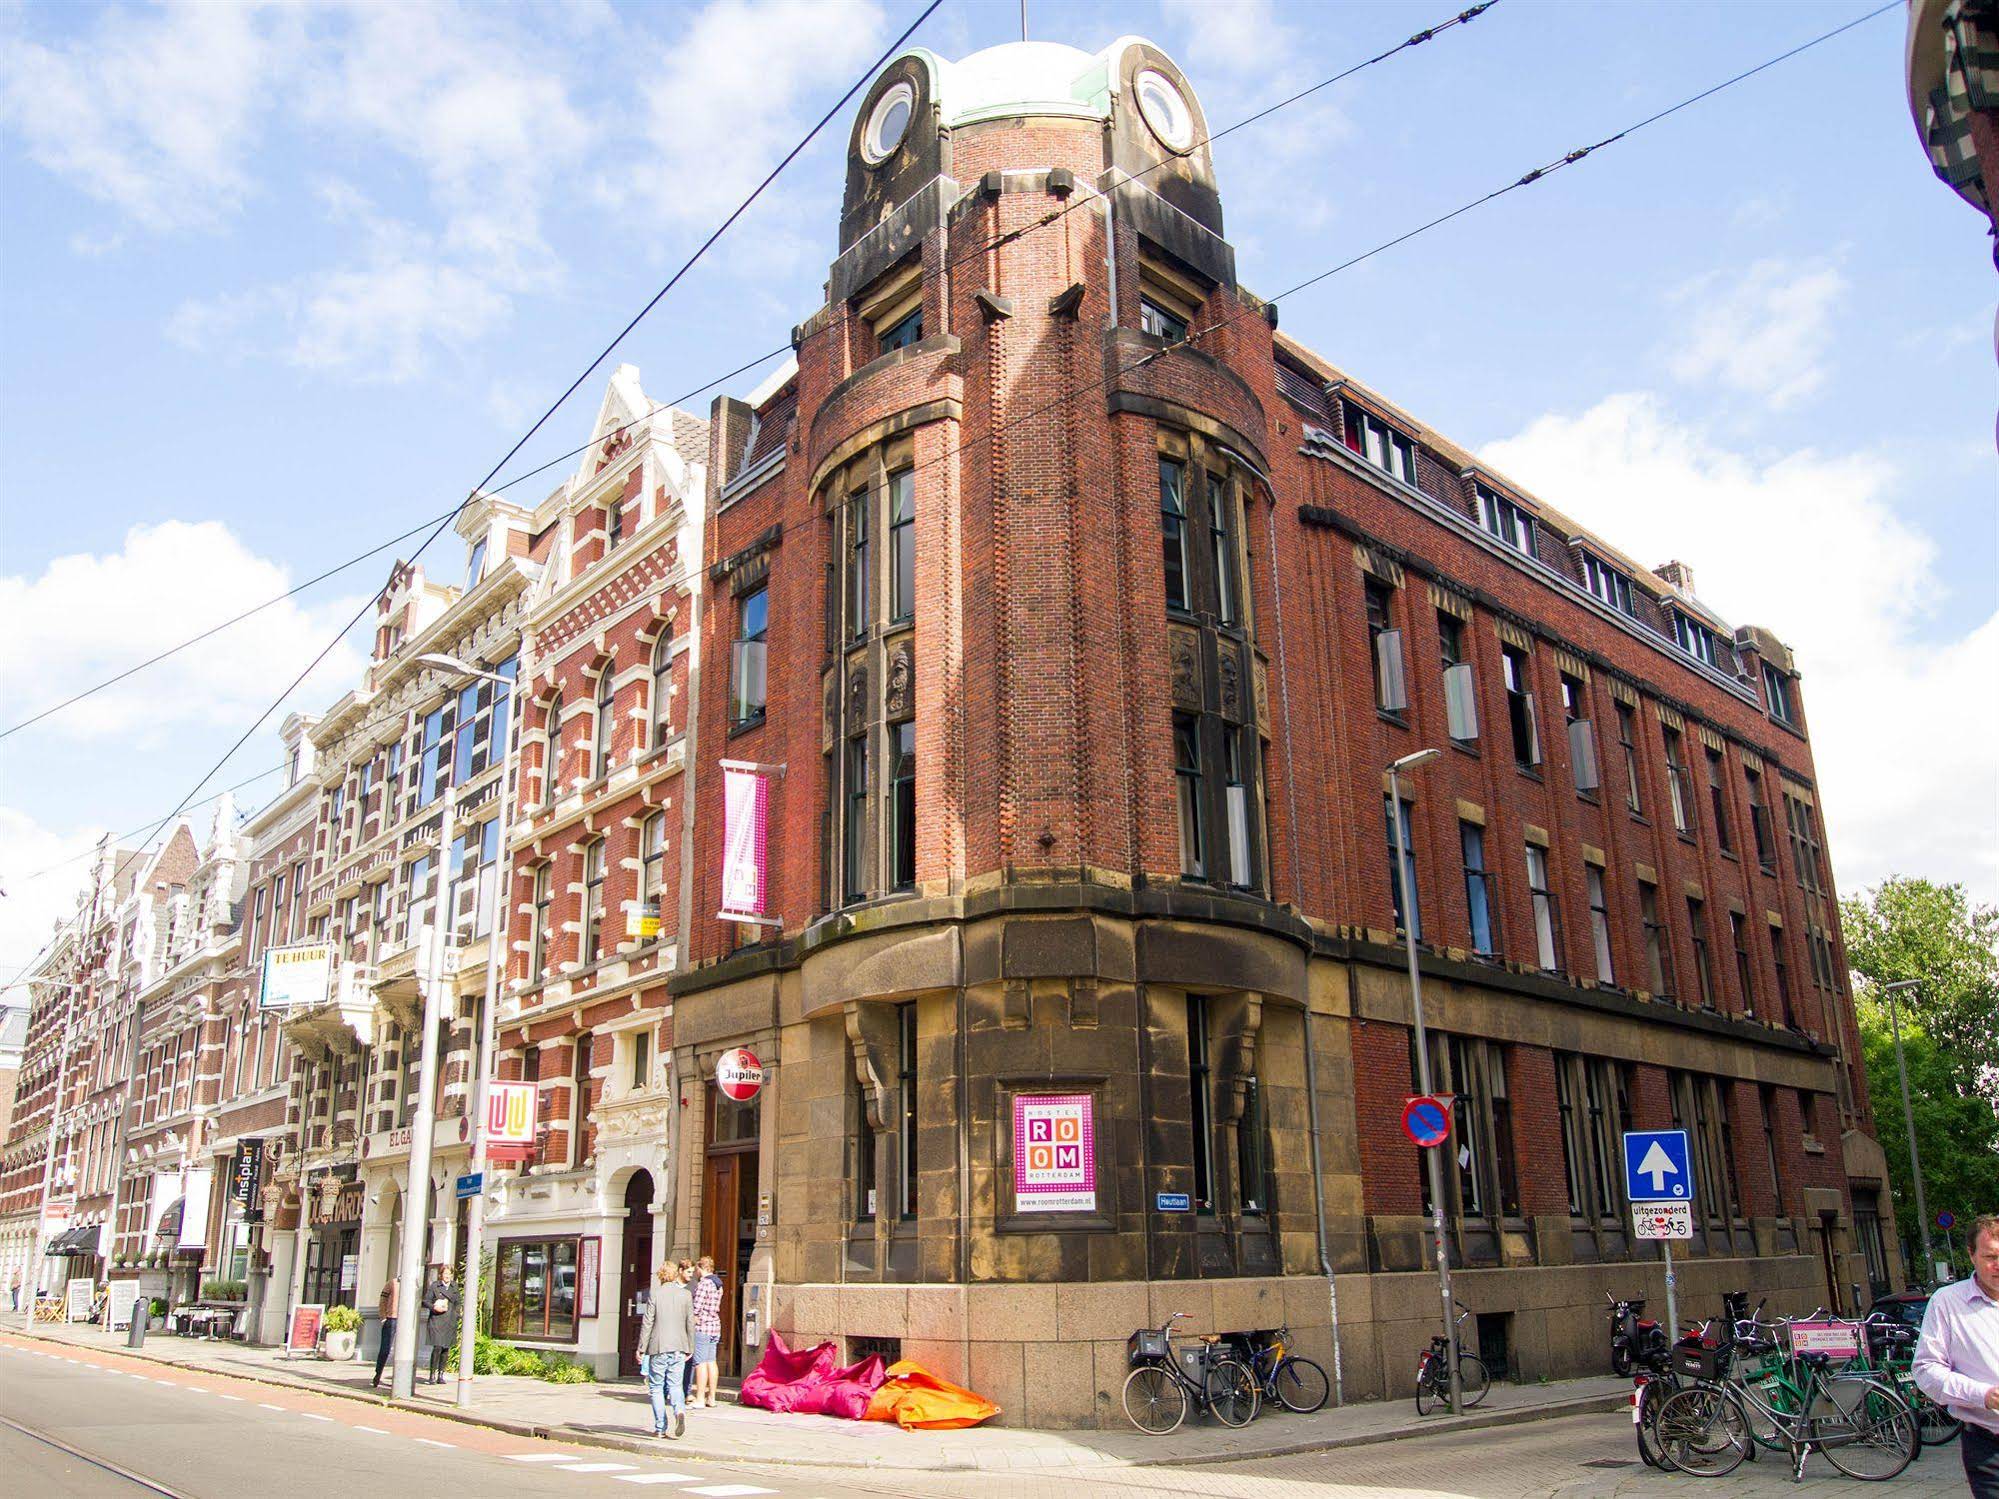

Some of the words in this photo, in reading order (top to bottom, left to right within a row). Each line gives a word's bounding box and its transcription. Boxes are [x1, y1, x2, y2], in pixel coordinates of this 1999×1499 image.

[275, 953, 289, 964] TE
[292, 949, 326, 962] HUUR
[724, 1068, 761, 1081] Jupiler
[1028, 1108, 1078, 1116] HOSTEL
[1020, 1197, 1092, 1207] www.roomrotterdam.nl
[1633, 1206, 1687, 1216] uitgezonderd
